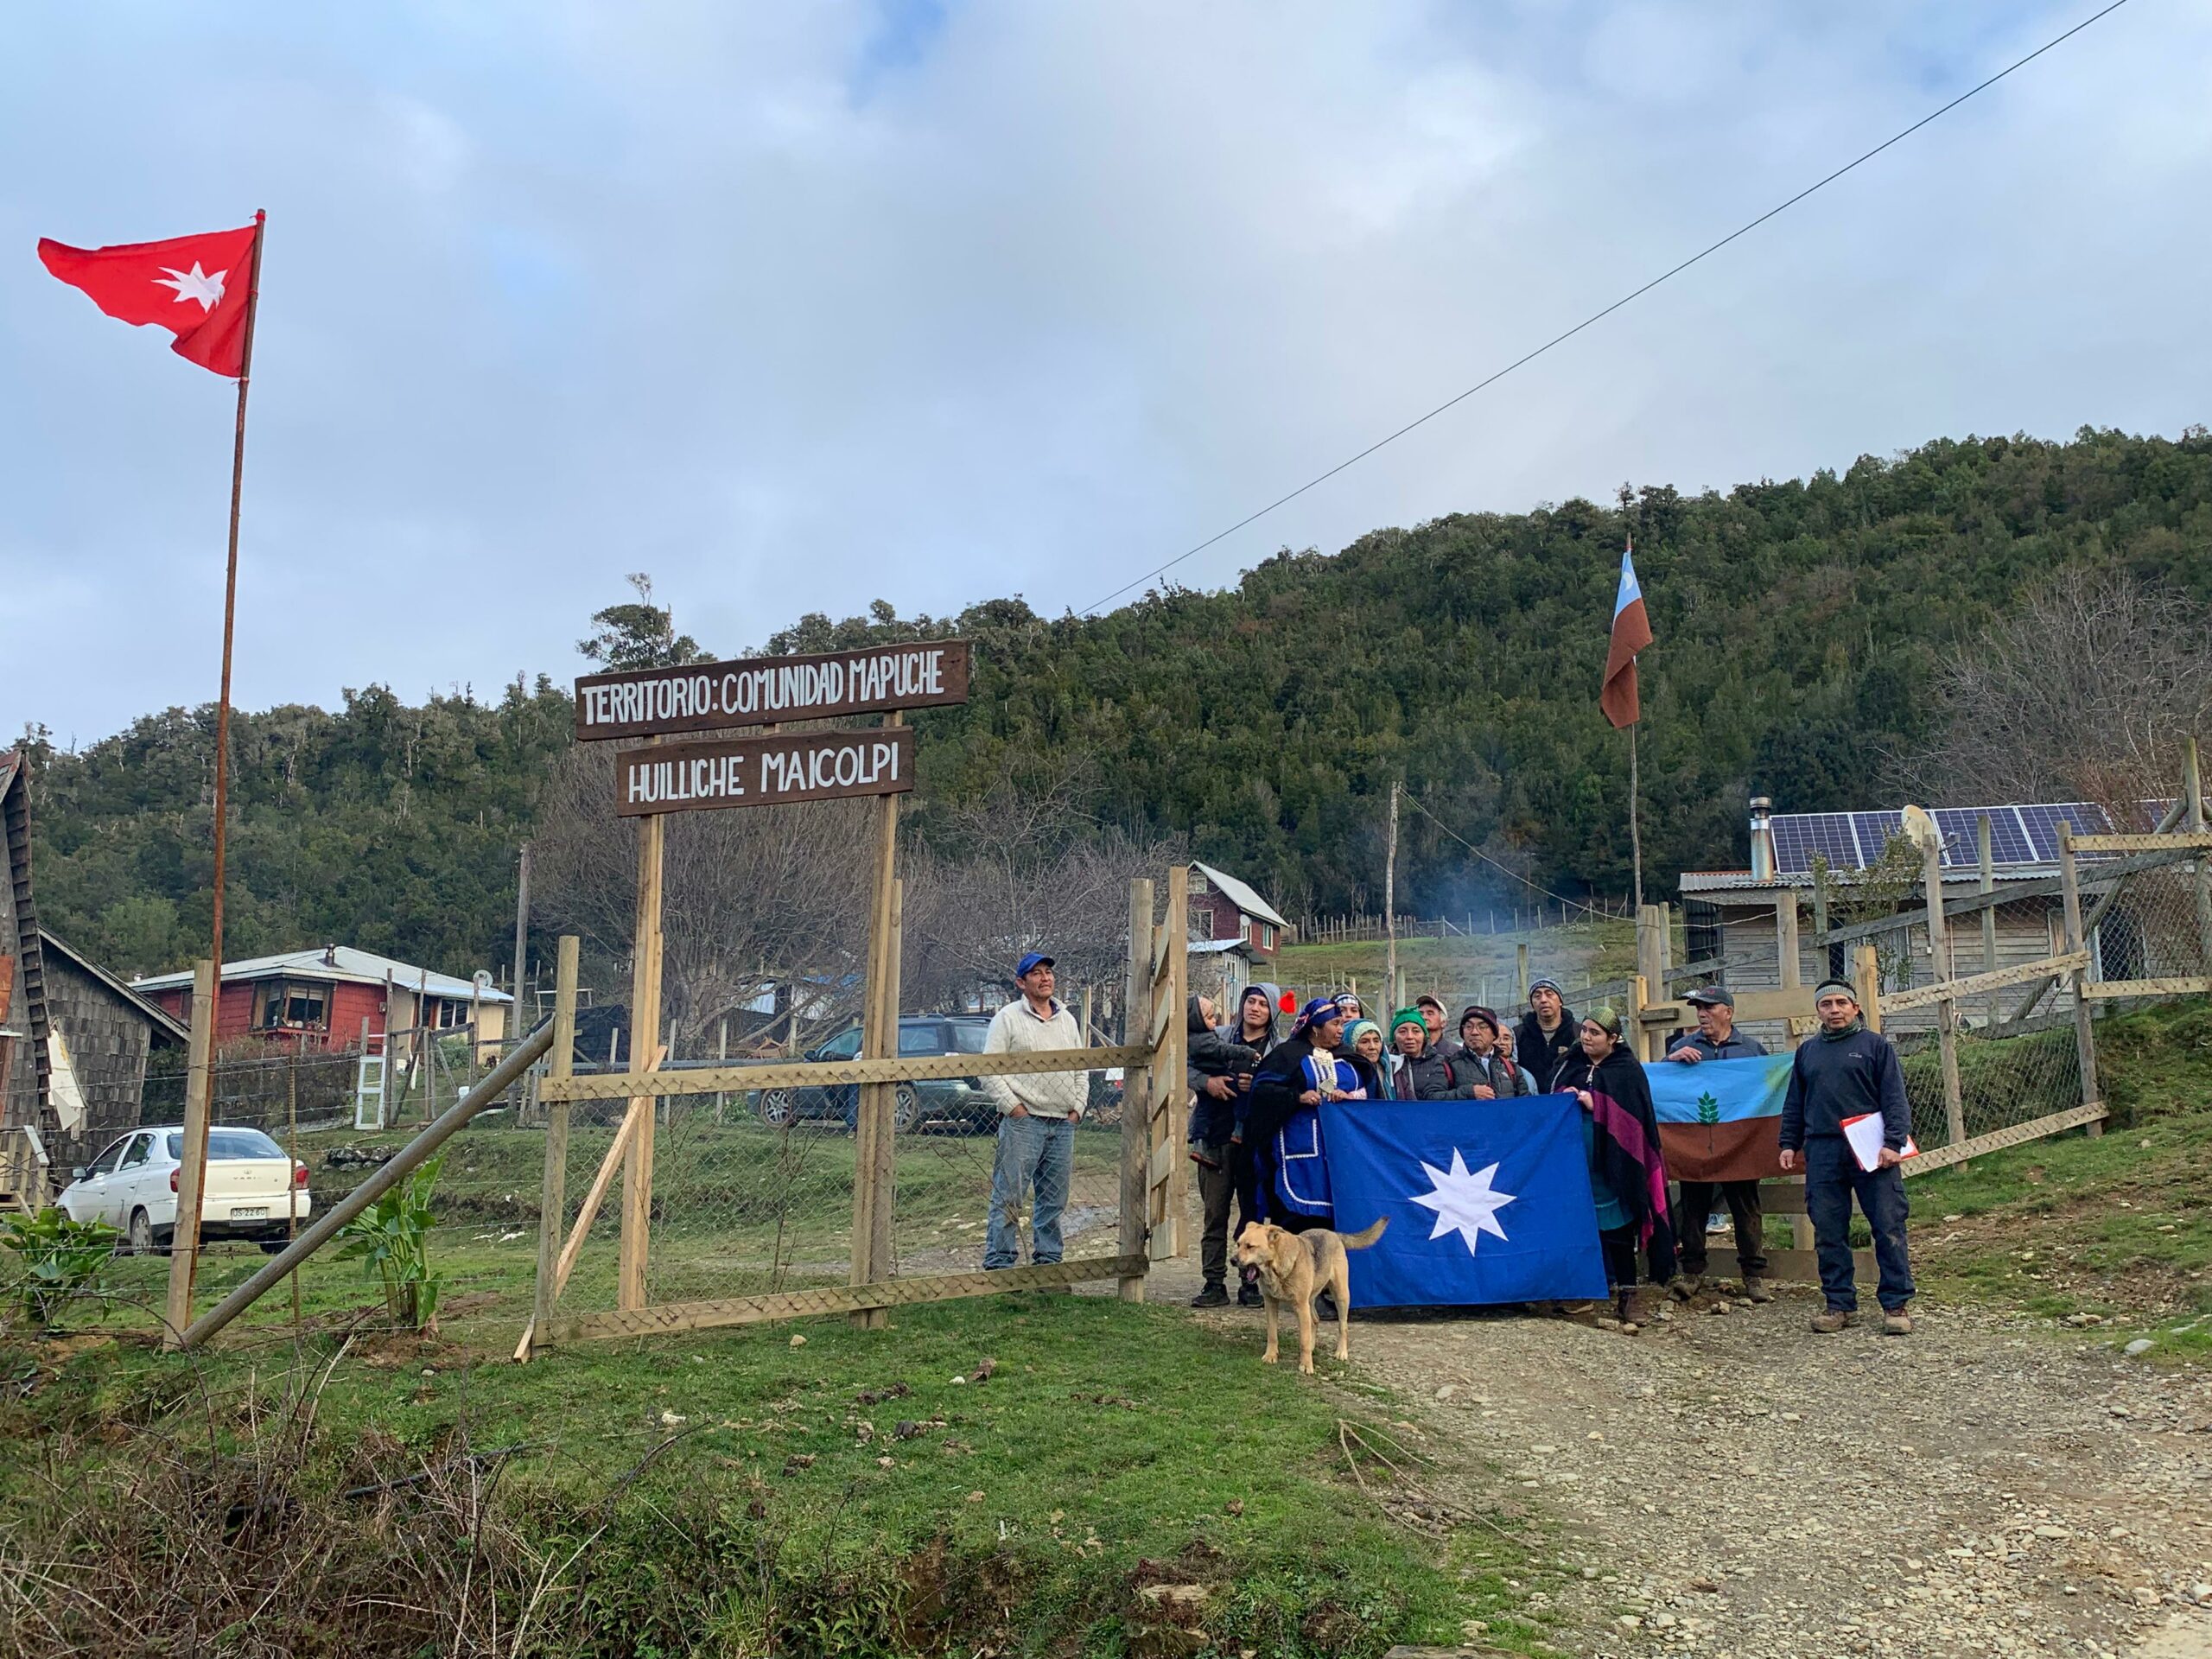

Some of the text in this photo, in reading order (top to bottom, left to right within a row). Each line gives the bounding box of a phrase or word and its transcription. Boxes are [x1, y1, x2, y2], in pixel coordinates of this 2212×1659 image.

[582, 650, 944, 725] TERRITORIO: COMUNIDAD MAPUCHE
[628, 741, 899, 804] HUILLICHE MAICOLPI
